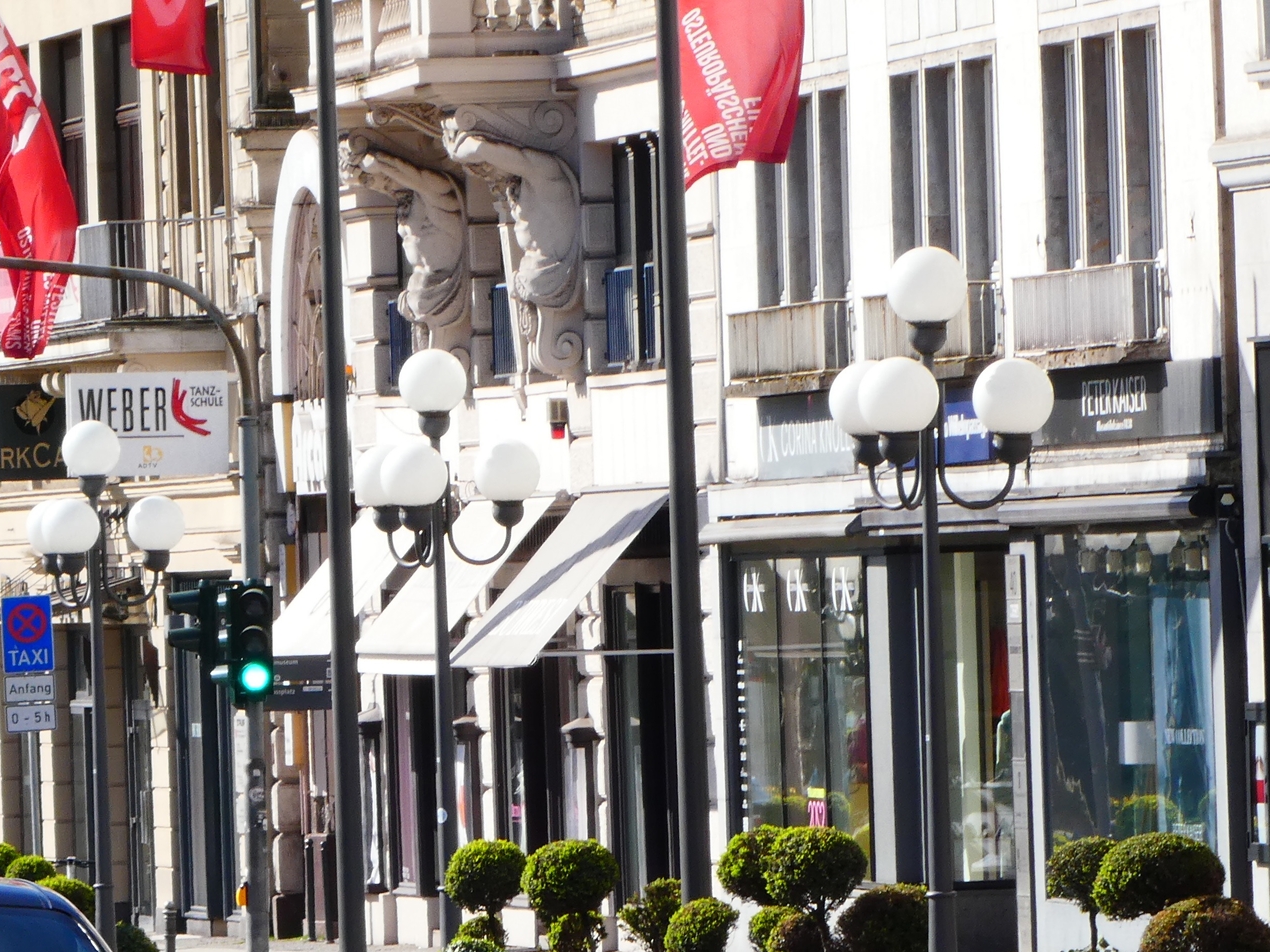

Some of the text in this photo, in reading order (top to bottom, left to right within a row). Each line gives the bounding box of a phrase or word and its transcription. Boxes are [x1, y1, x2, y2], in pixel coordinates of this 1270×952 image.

[190, 386, 221, 396] TANZ-
[1082, 376, 1147, 417] PETER KAISER
[78, 386, 167, 433] WEBER
[190, 396, 223, 407] SCHULE
[781, 420, 818, 457] CORINA
[7, 648, 49, 667] TAXI
[9, 684, 52, 695] Anfang
